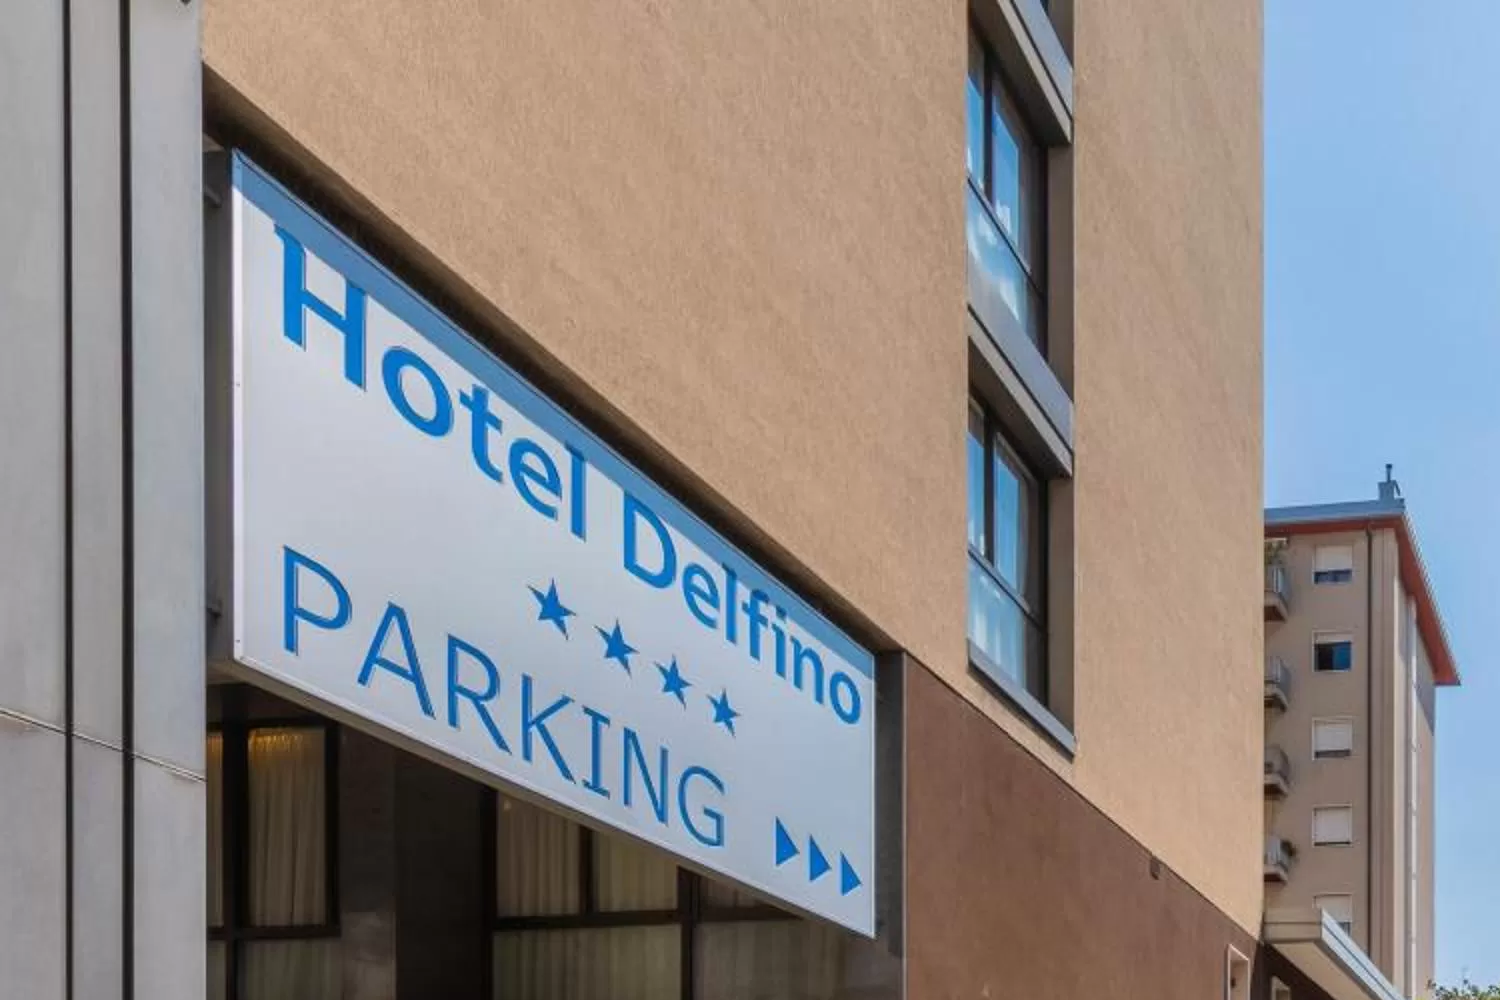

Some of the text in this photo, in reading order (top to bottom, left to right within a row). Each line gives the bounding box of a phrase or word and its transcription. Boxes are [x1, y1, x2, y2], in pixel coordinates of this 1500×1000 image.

[274, 224, 862, 725] Hotel Delfino
[282, 544, 727, 849] PARKING
